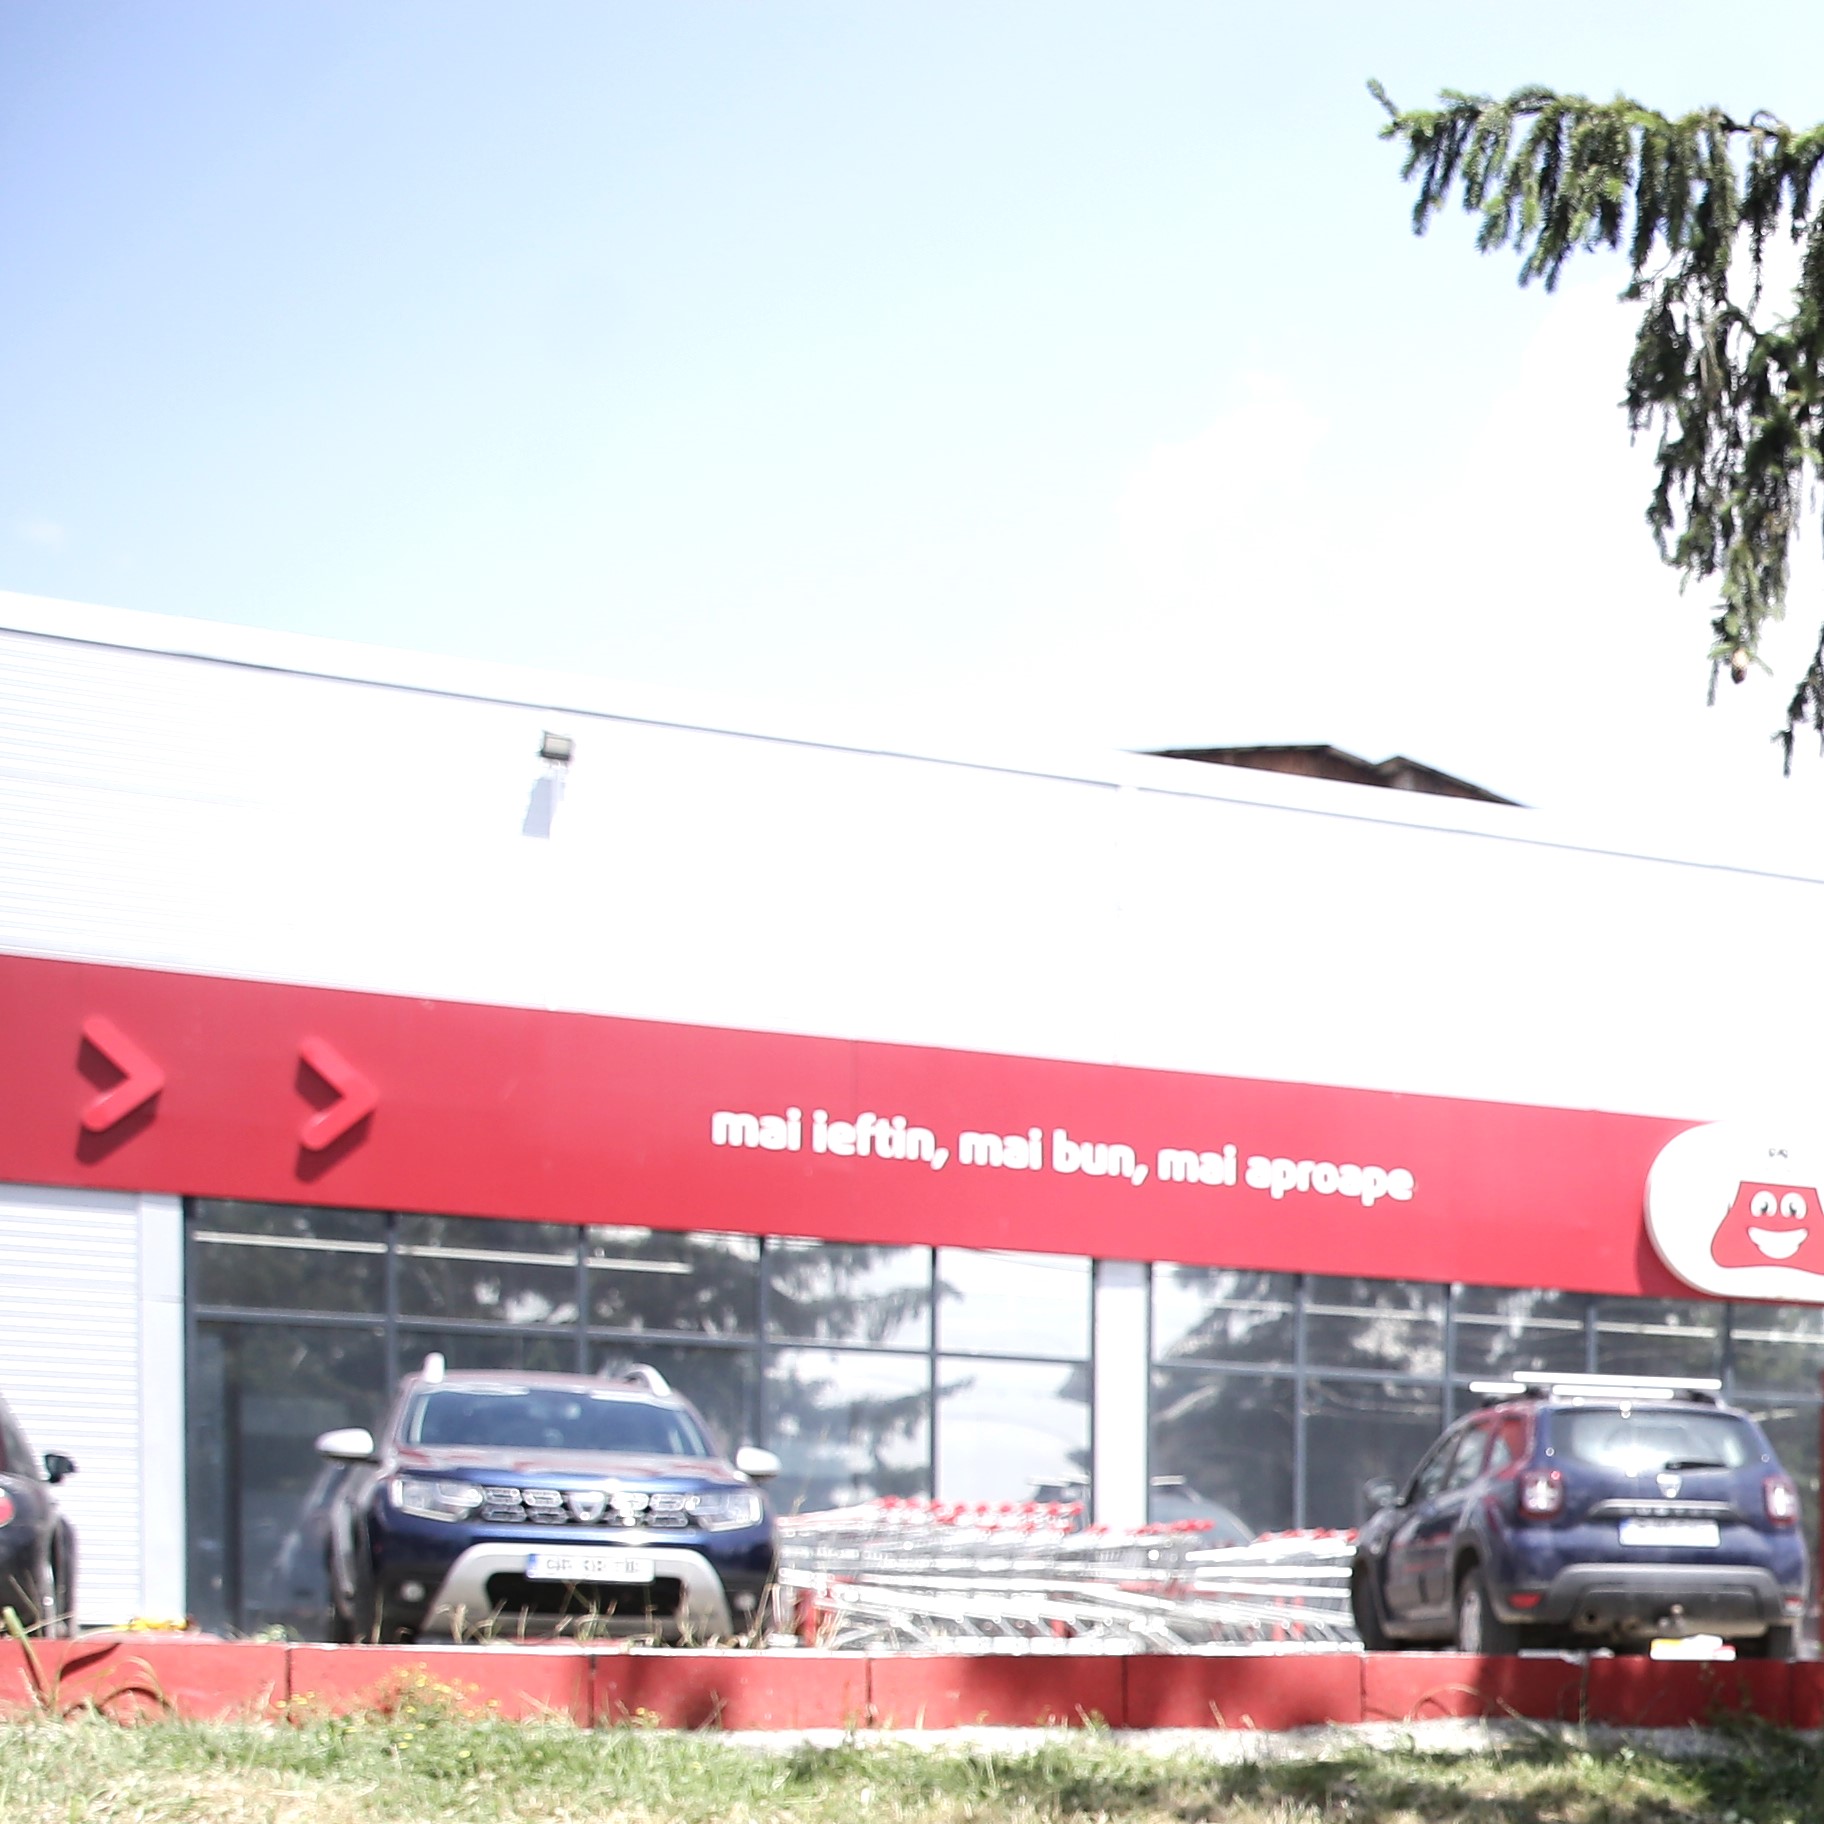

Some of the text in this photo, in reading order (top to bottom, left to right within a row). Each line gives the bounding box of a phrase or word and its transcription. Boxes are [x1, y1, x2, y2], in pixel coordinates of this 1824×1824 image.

[711, 1106, 1415, 1207] mai ieftin, mai bun, mai aproape
